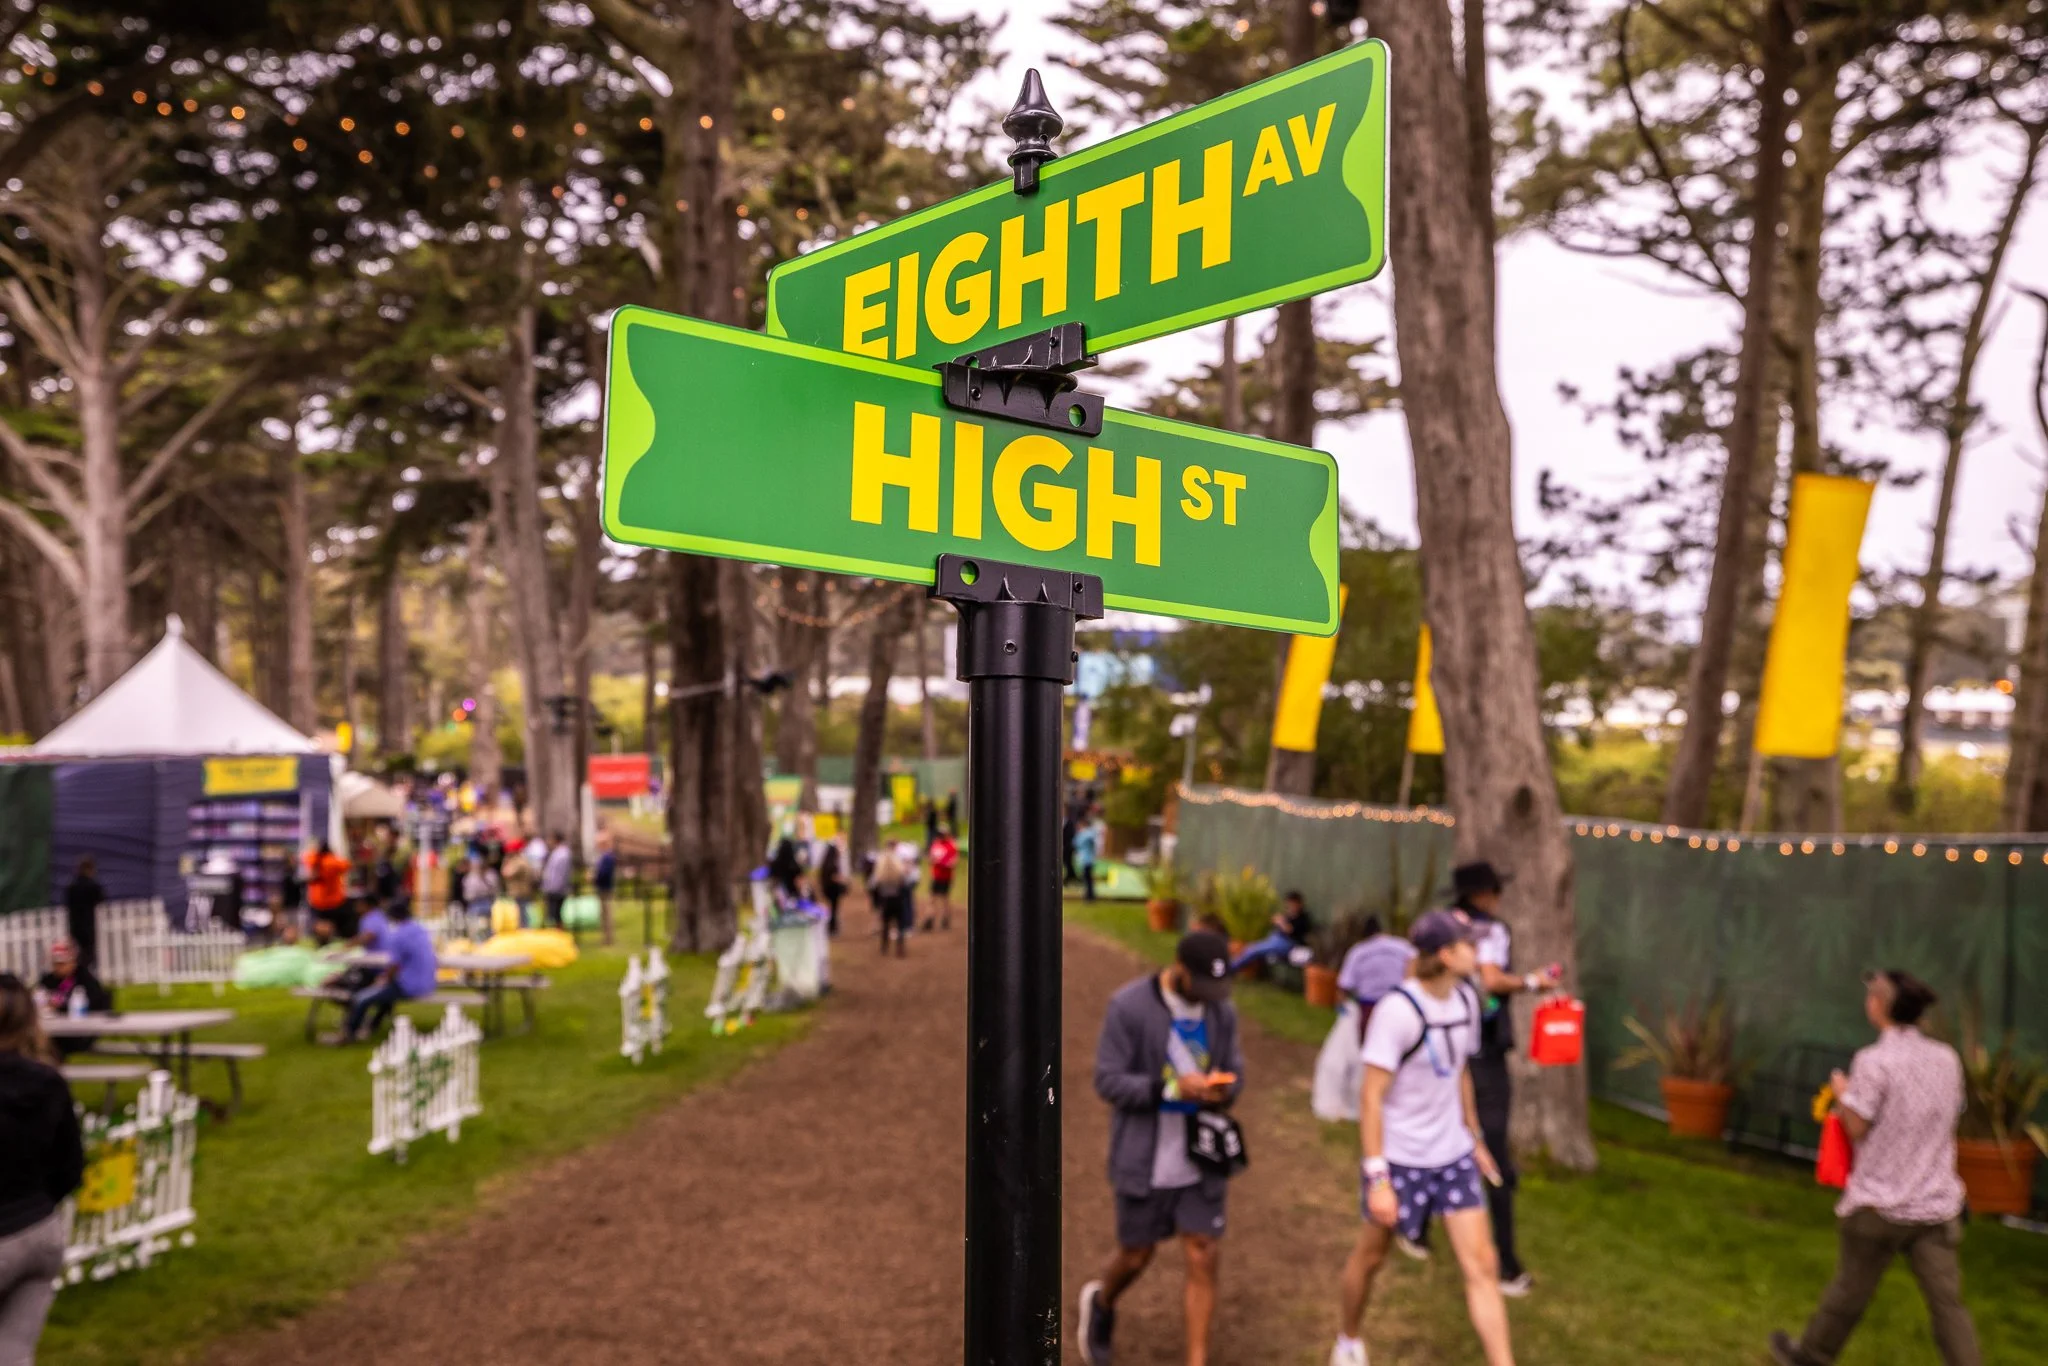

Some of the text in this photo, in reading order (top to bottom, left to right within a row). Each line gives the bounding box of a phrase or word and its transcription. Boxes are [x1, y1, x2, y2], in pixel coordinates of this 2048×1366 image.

[843, 103, 1337, 360] EIGHTH AV
[851, 401, 1247, 567] HIGH ST
